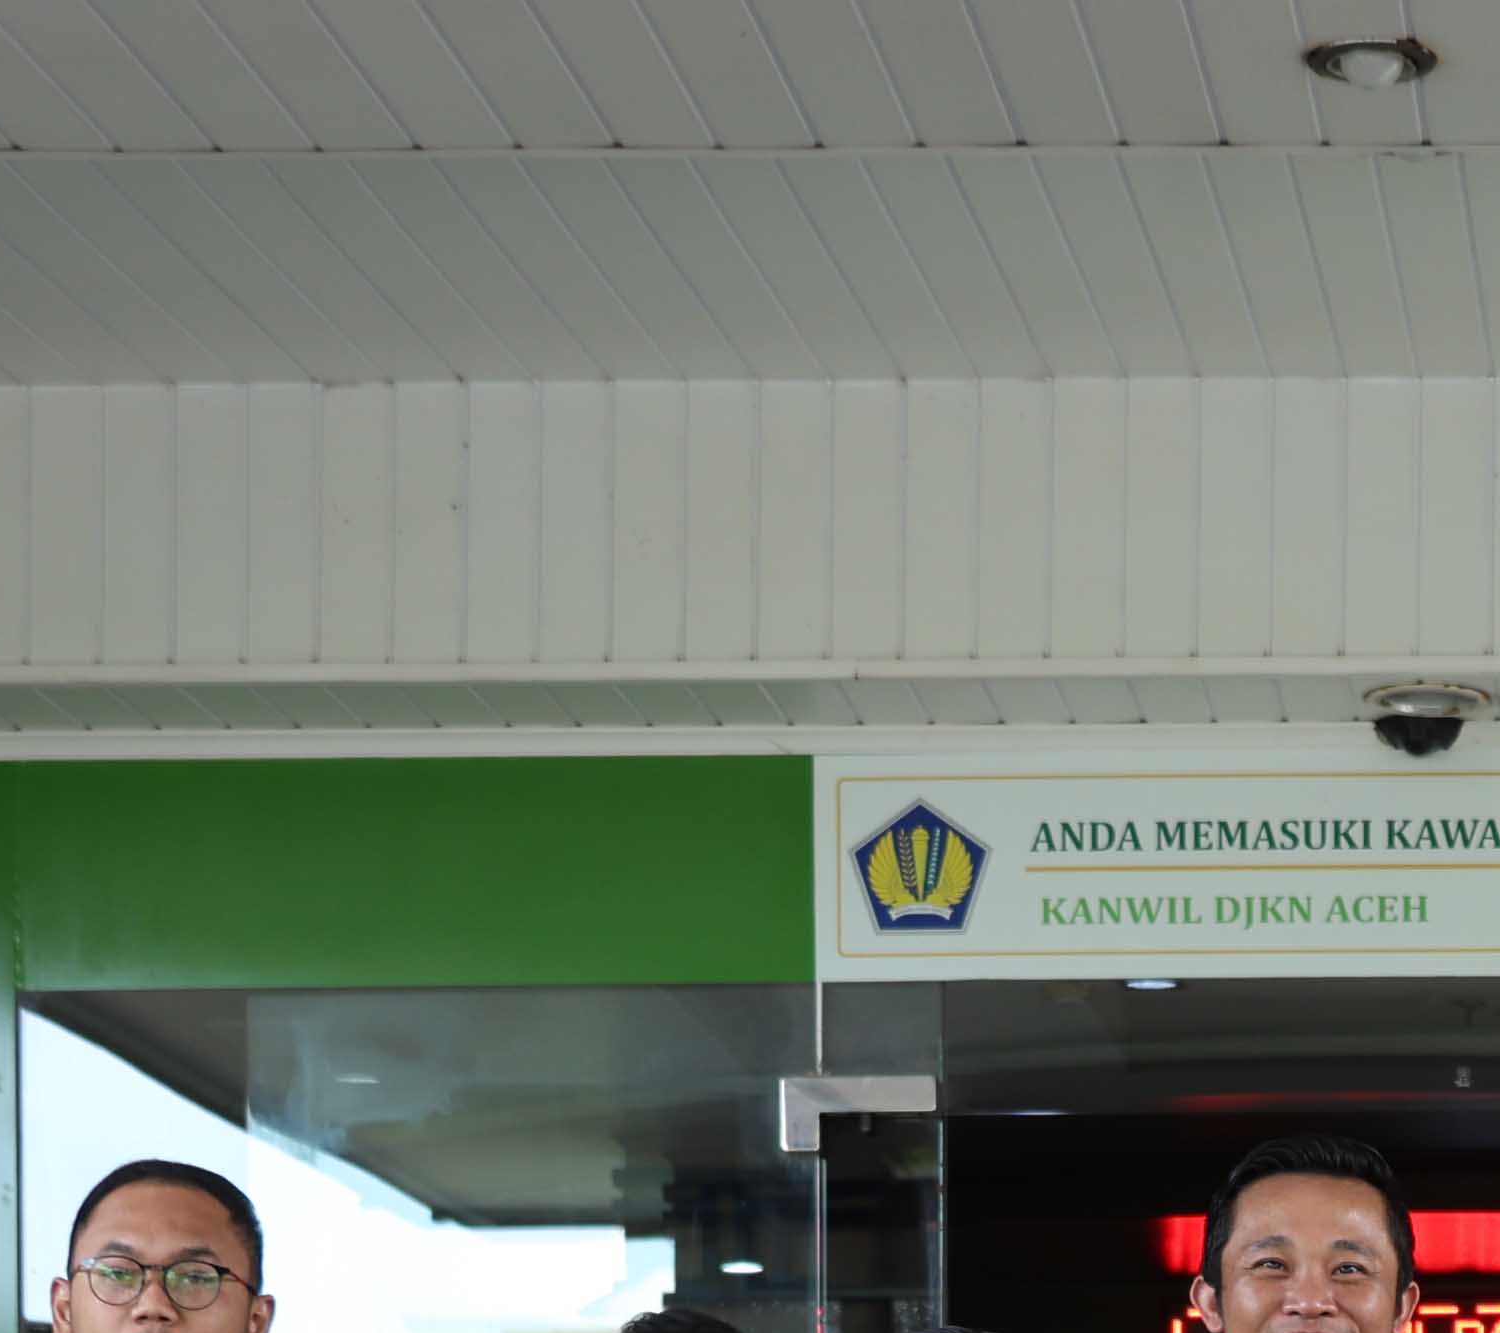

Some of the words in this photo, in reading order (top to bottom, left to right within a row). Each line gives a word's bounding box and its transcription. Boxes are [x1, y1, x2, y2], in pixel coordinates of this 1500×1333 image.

[1031, 820, 1143, 852] ANDA
[1155, 819, 1372, 852] MEMASUKI
[1040, 896, 1203, 926] KANWIL
[1213, 895, 1313, 930] DJKN
[1325, 896, 1430, 924] ACEH
